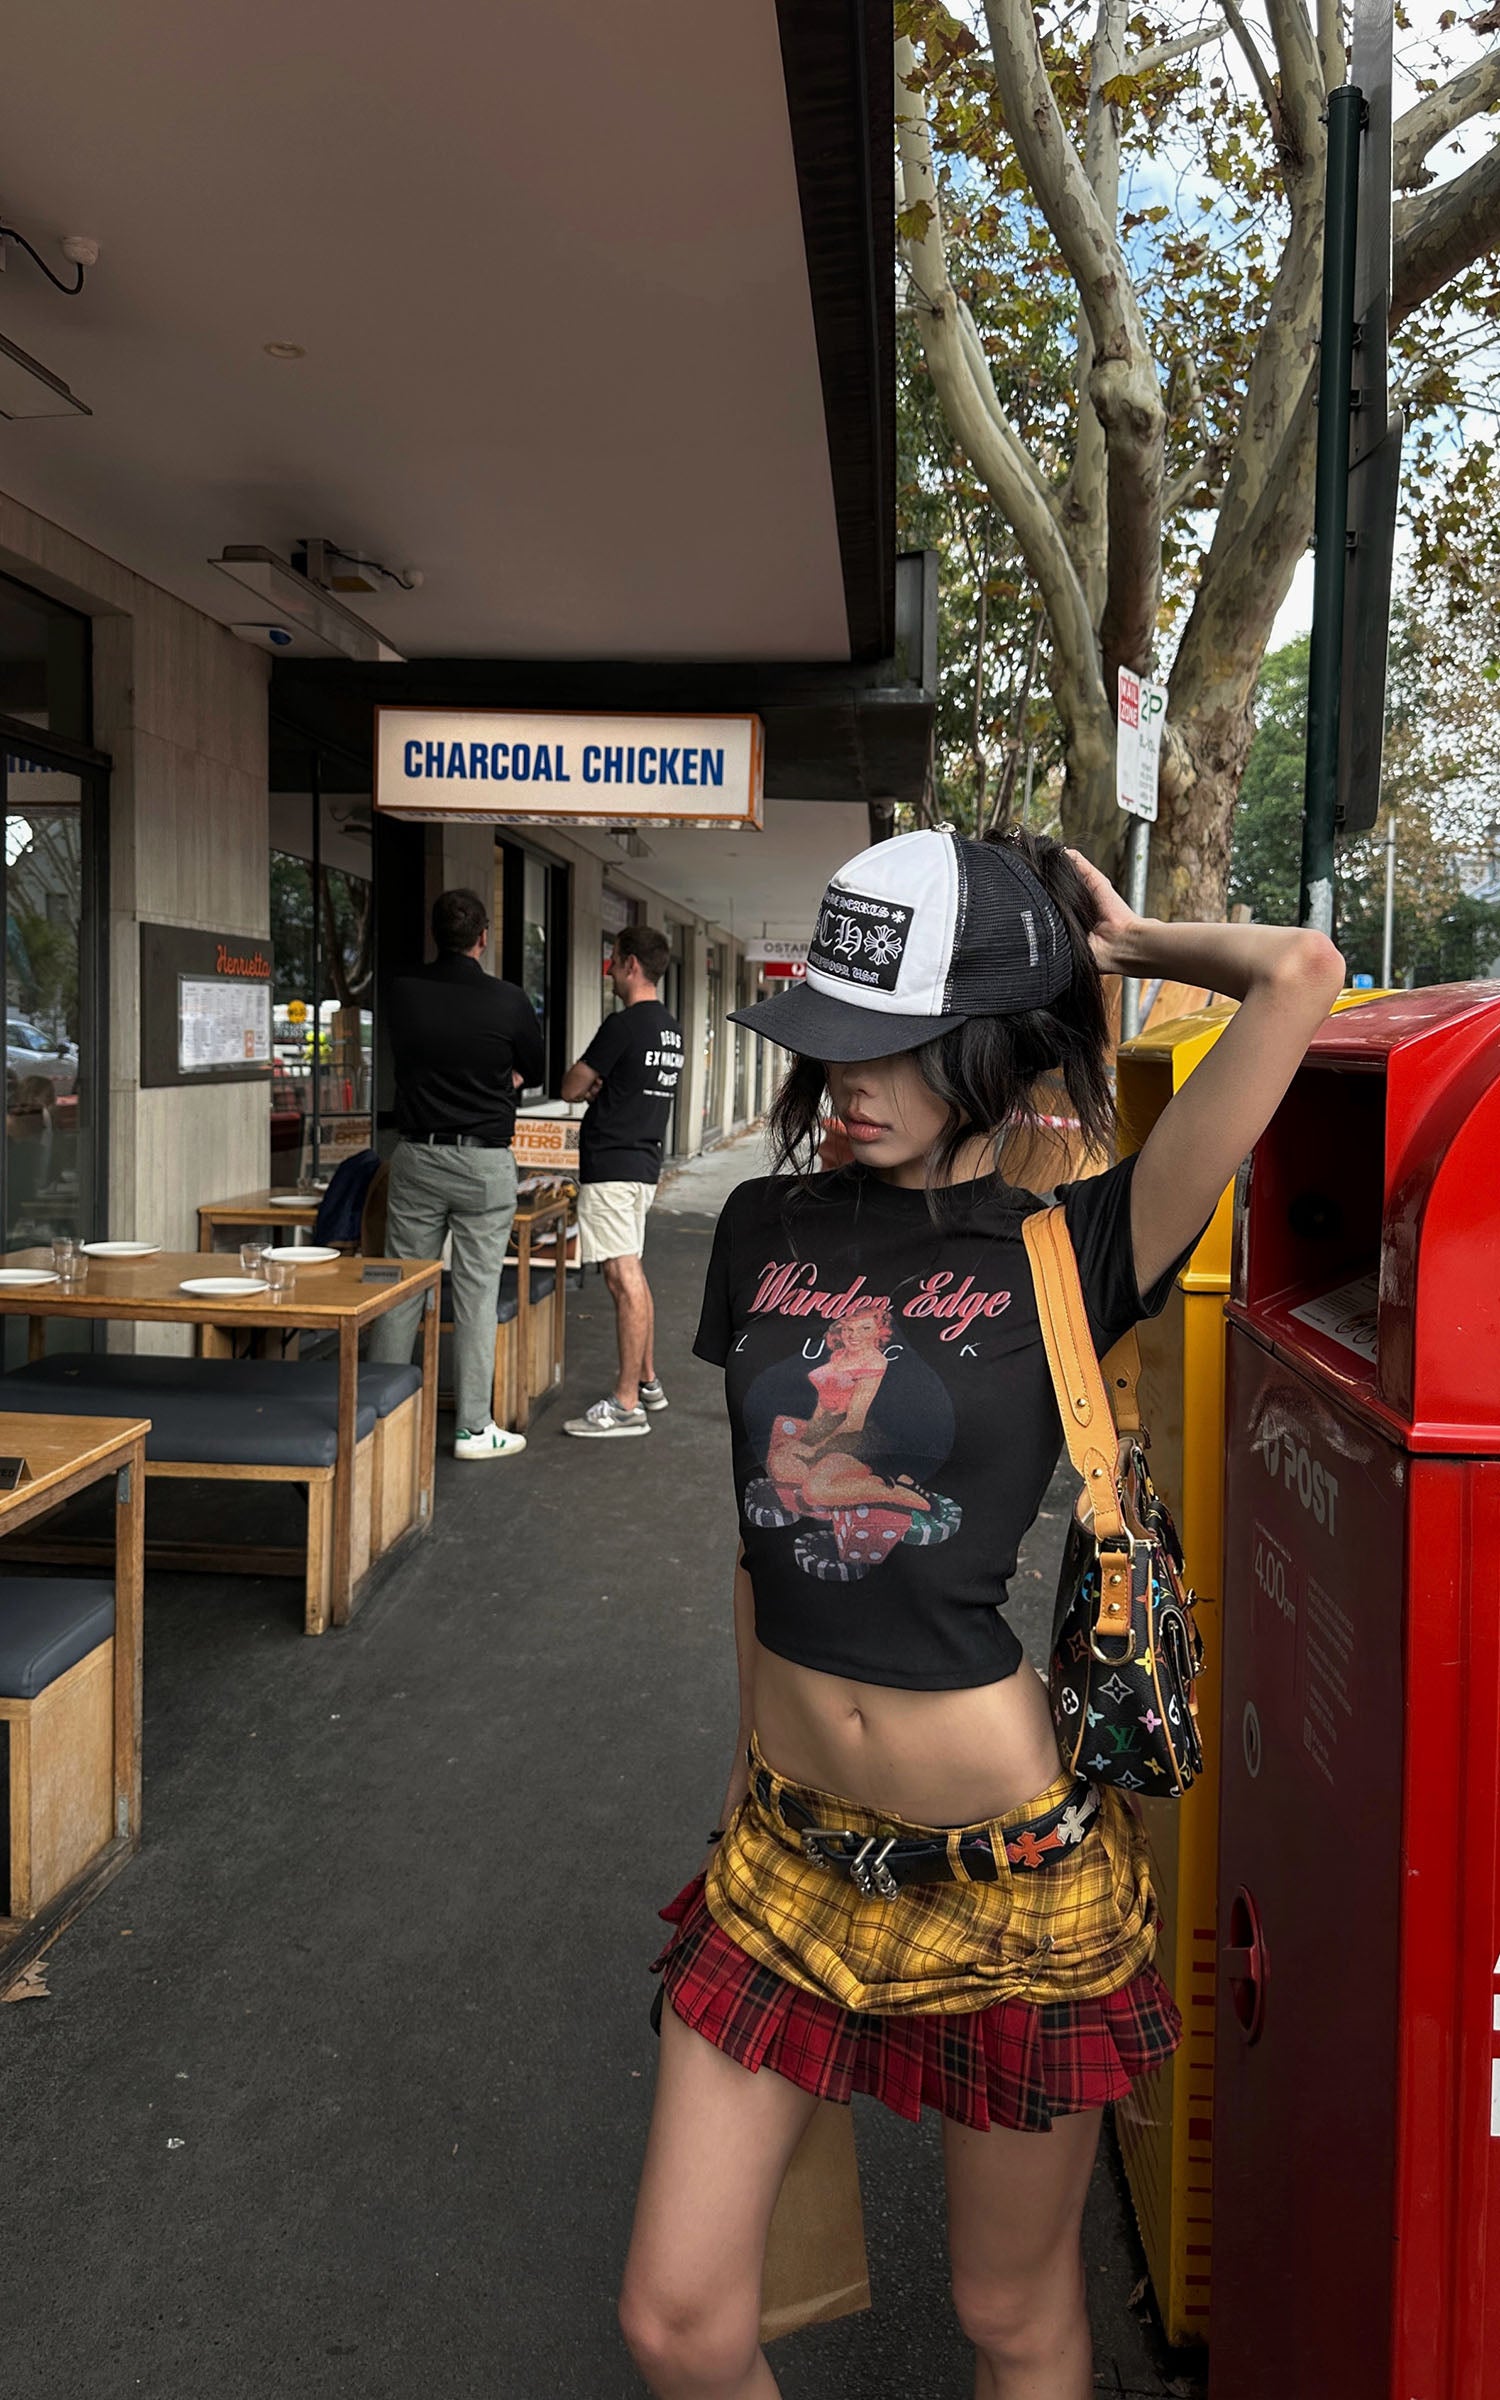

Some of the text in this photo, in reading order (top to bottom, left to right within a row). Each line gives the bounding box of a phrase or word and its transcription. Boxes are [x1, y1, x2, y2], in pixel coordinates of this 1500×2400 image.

[1120, 701, 1138, 726] ZONE
[1141, 689, 1163, 723] 2P
[404, 740, 724, 786] CHARCOAL CHICKEN
[216, 944, 271, 977] Henrietta
[852, 967, 880, 984] USA
[645, 1050, 661, 1066] EX
[902, 1271, 1011, 1342] Edge
[1283, 1433, 1339, 1537] POST
